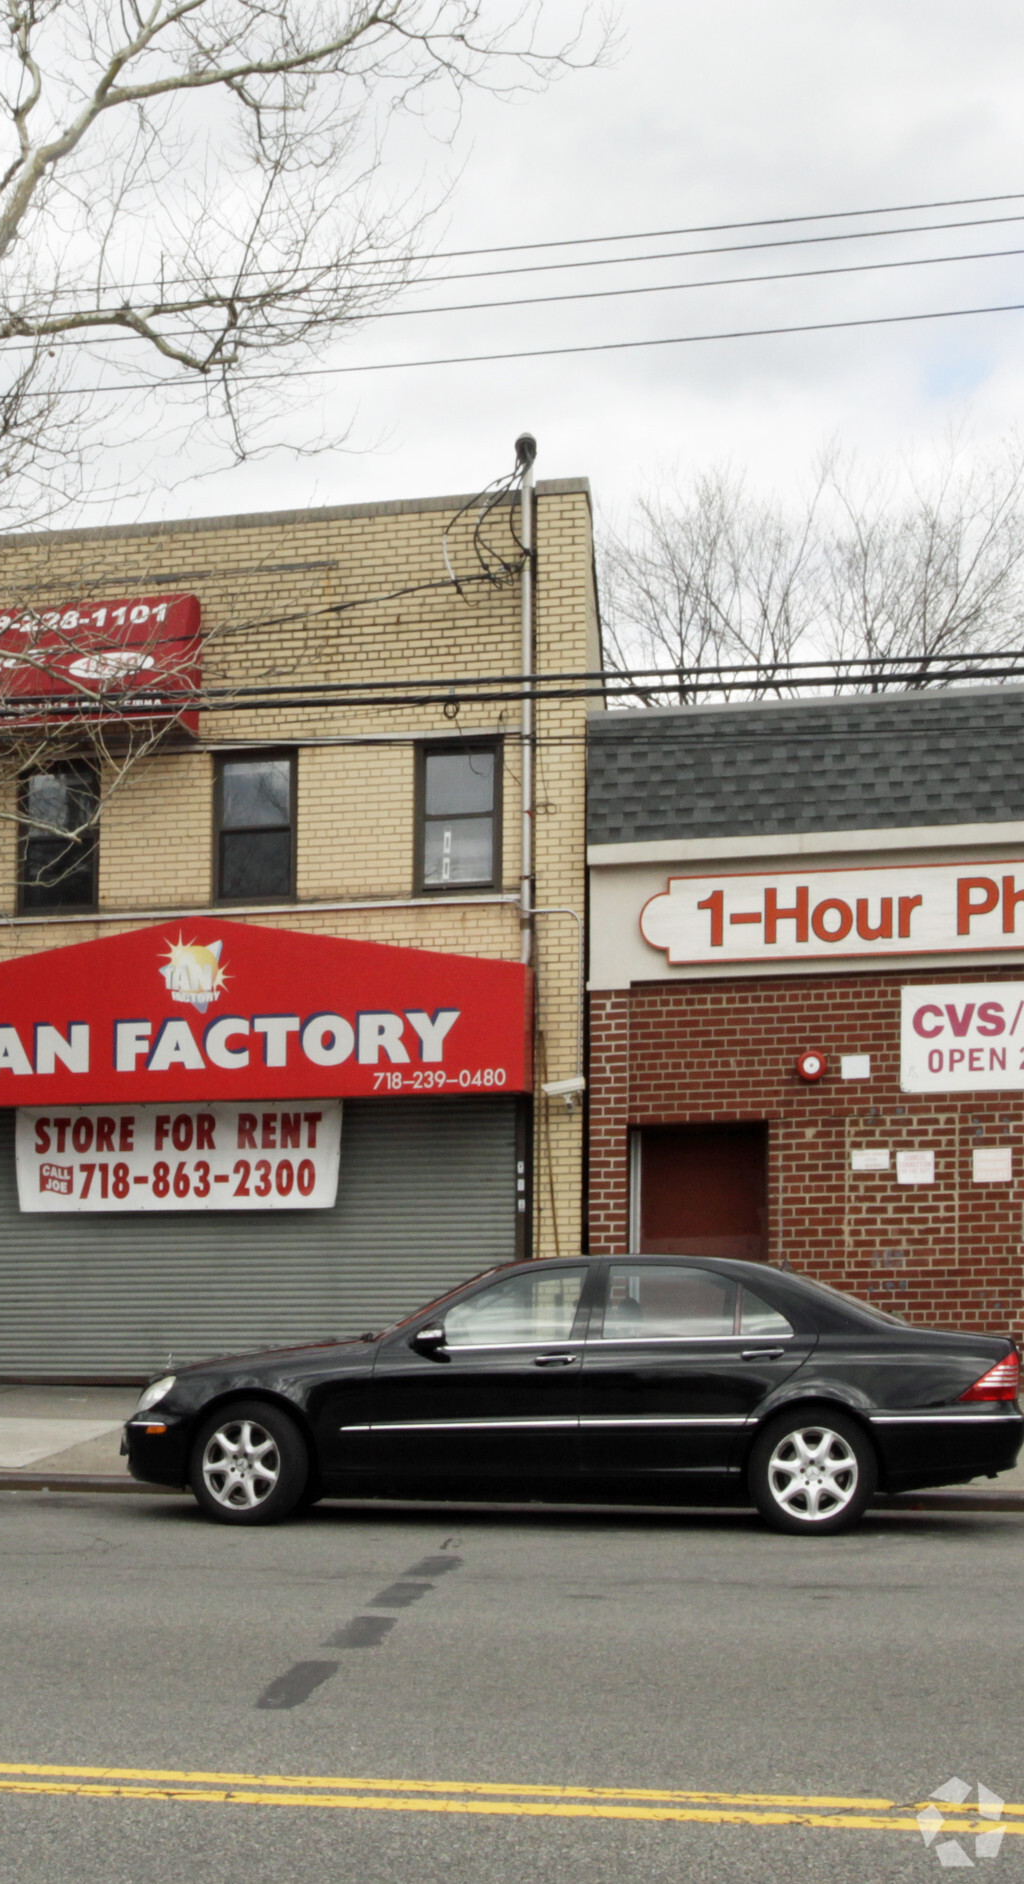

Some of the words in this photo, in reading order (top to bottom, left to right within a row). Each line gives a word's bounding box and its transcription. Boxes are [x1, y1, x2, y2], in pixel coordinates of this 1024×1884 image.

[697, 886, 922, 946] 1-Hour
[112, 1007, 461, 1072] FACTORY
[928, 1047, 1007, 1074] OPEN
[373, 1068, 506, 1090] 718-239-0480
[34, 1116, 135, 1154] STORE
[155, 1113, 216, 1151] FOR
[237, 1112, 322, 1149] RENT
[42, 1165, 70, 1180] CALL
[46, 1178, 68, 1193] JOE
[79, 1159, 316, 1199] 718-863-2300
